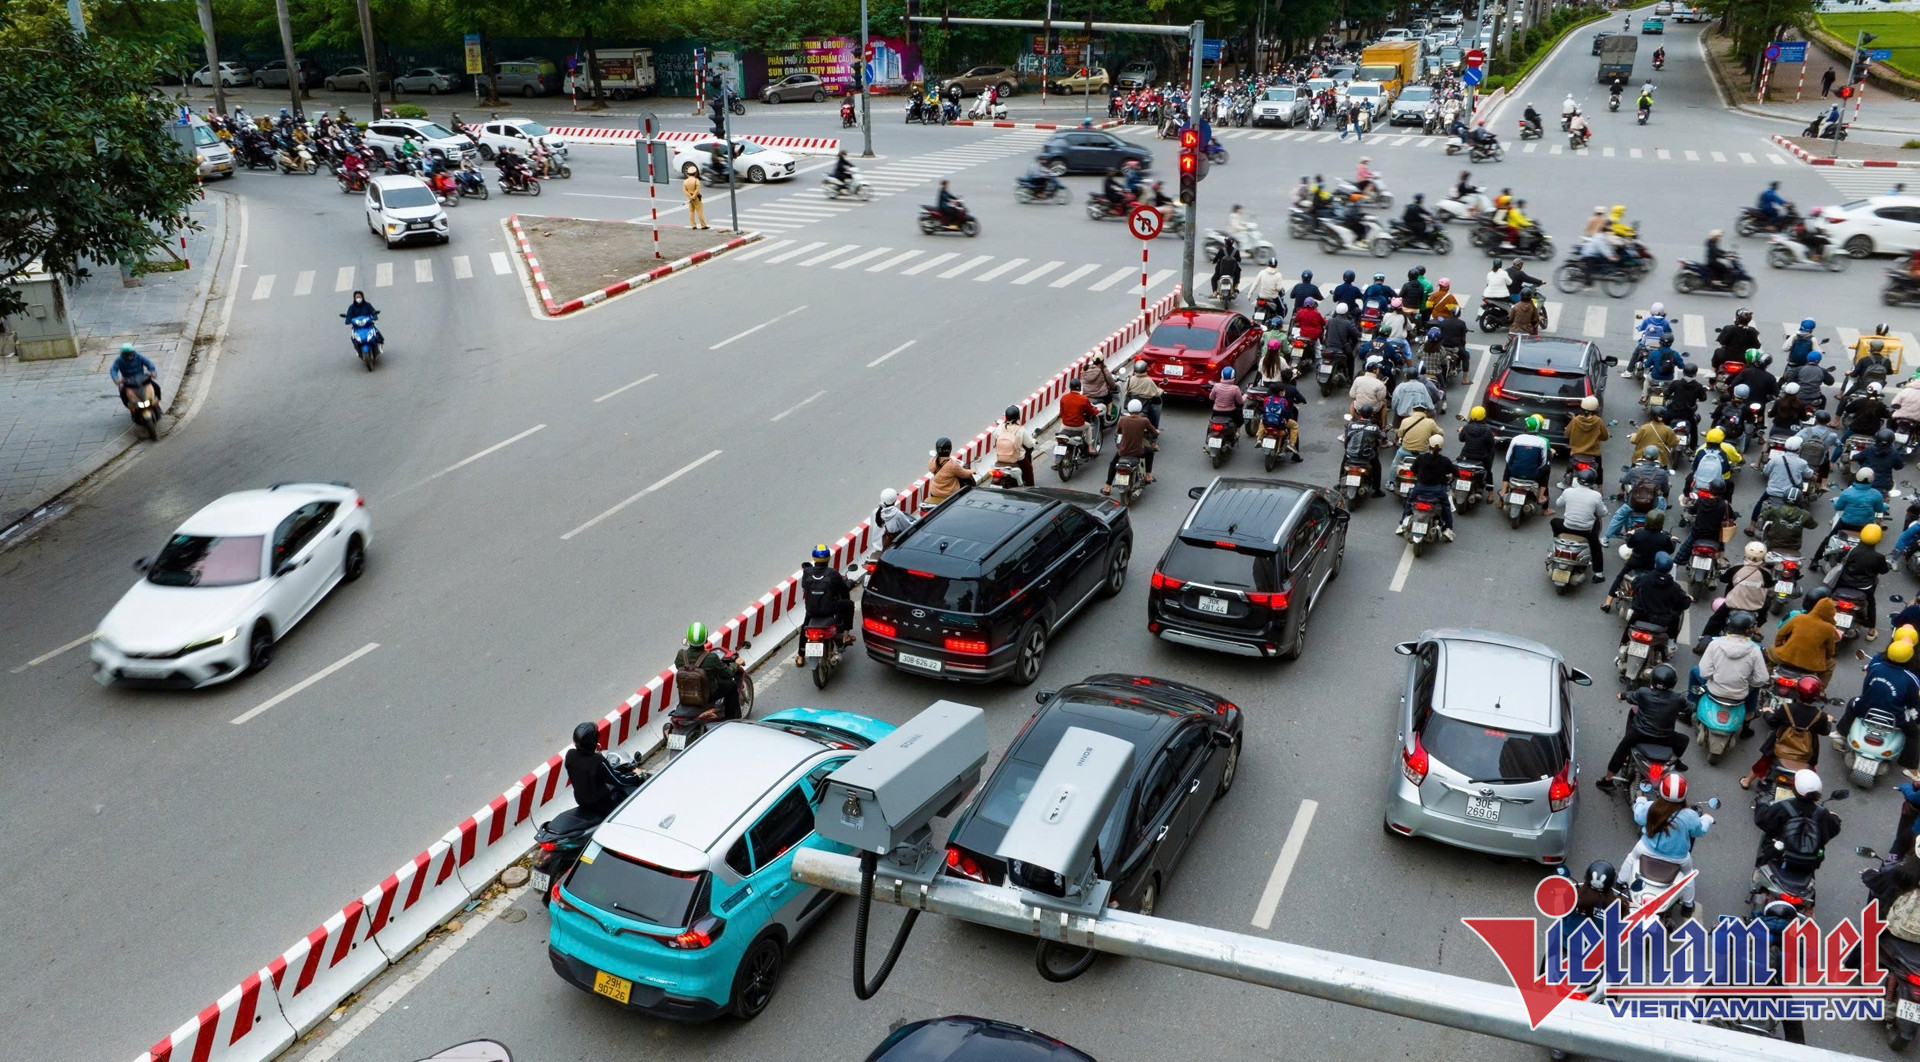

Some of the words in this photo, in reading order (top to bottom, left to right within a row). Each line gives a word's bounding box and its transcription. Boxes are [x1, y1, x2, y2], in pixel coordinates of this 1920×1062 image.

[823, 40, 845, 48] GROUP
[810, 66, 825, 75] CITY
[882, 616, 932, 632] SANTA
[1476, 799, 1493, 809] 30E
[1466, 806, 1499, 820] 269.05
[605, 975, 622, 988] 29H
[598, 983, 625, 1001] 907.26
